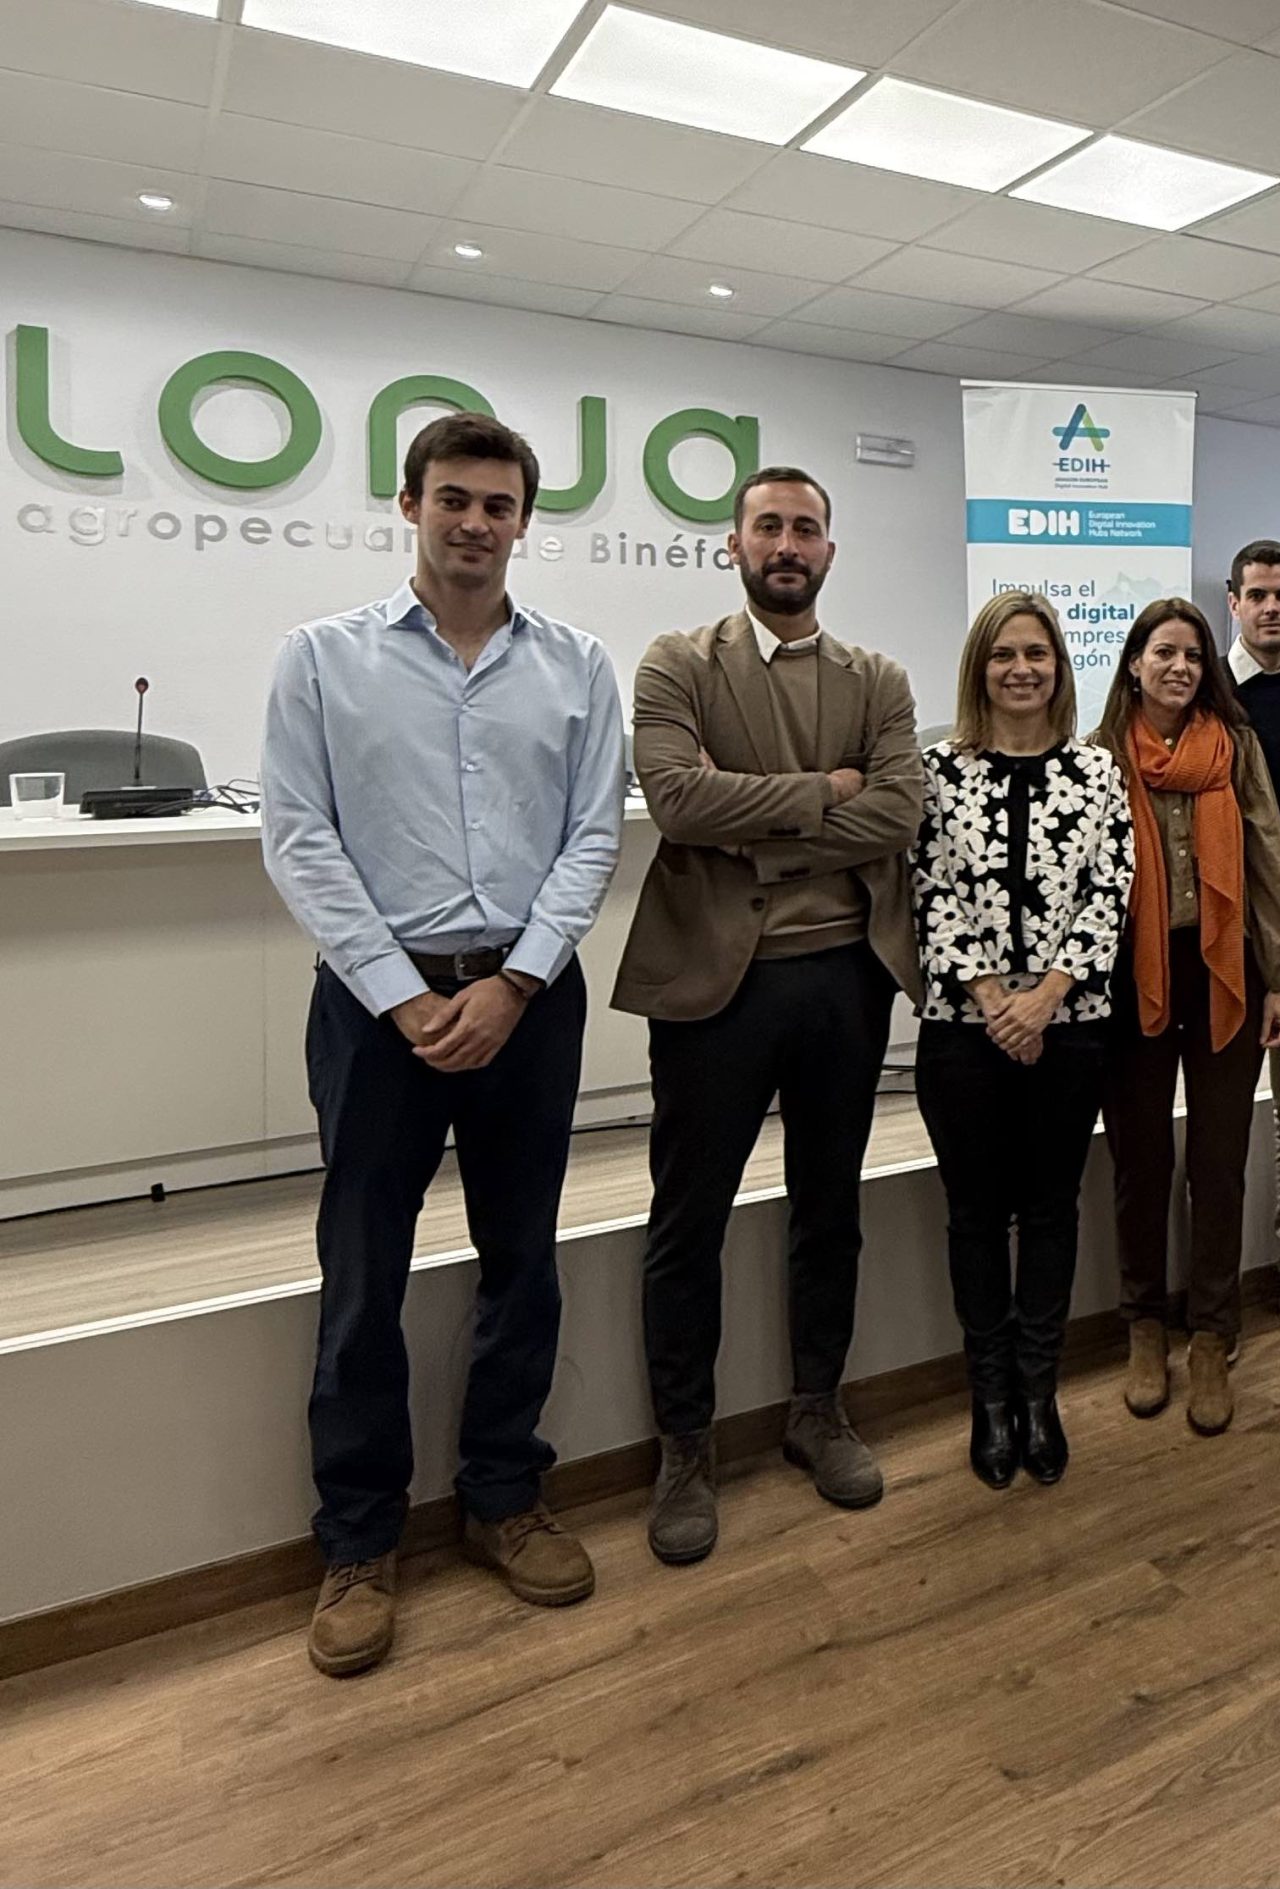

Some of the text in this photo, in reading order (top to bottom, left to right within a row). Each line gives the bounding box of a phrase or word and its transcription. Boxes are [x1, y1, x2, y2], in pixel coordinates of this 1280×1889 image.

[1058, 457, 1105, 473] EDIH
[1008, 508, 1080, 536] EDIH
[17, 502, 417, 553] agropecuar
[590, 531, 736, 571] Binéfa
[1079, 579, 1095, 597] el
[1067, 603, 1134, 624] digital
[1064, 630, 1125, 647] mpres
[1073, 648, 1111, 671] gón
